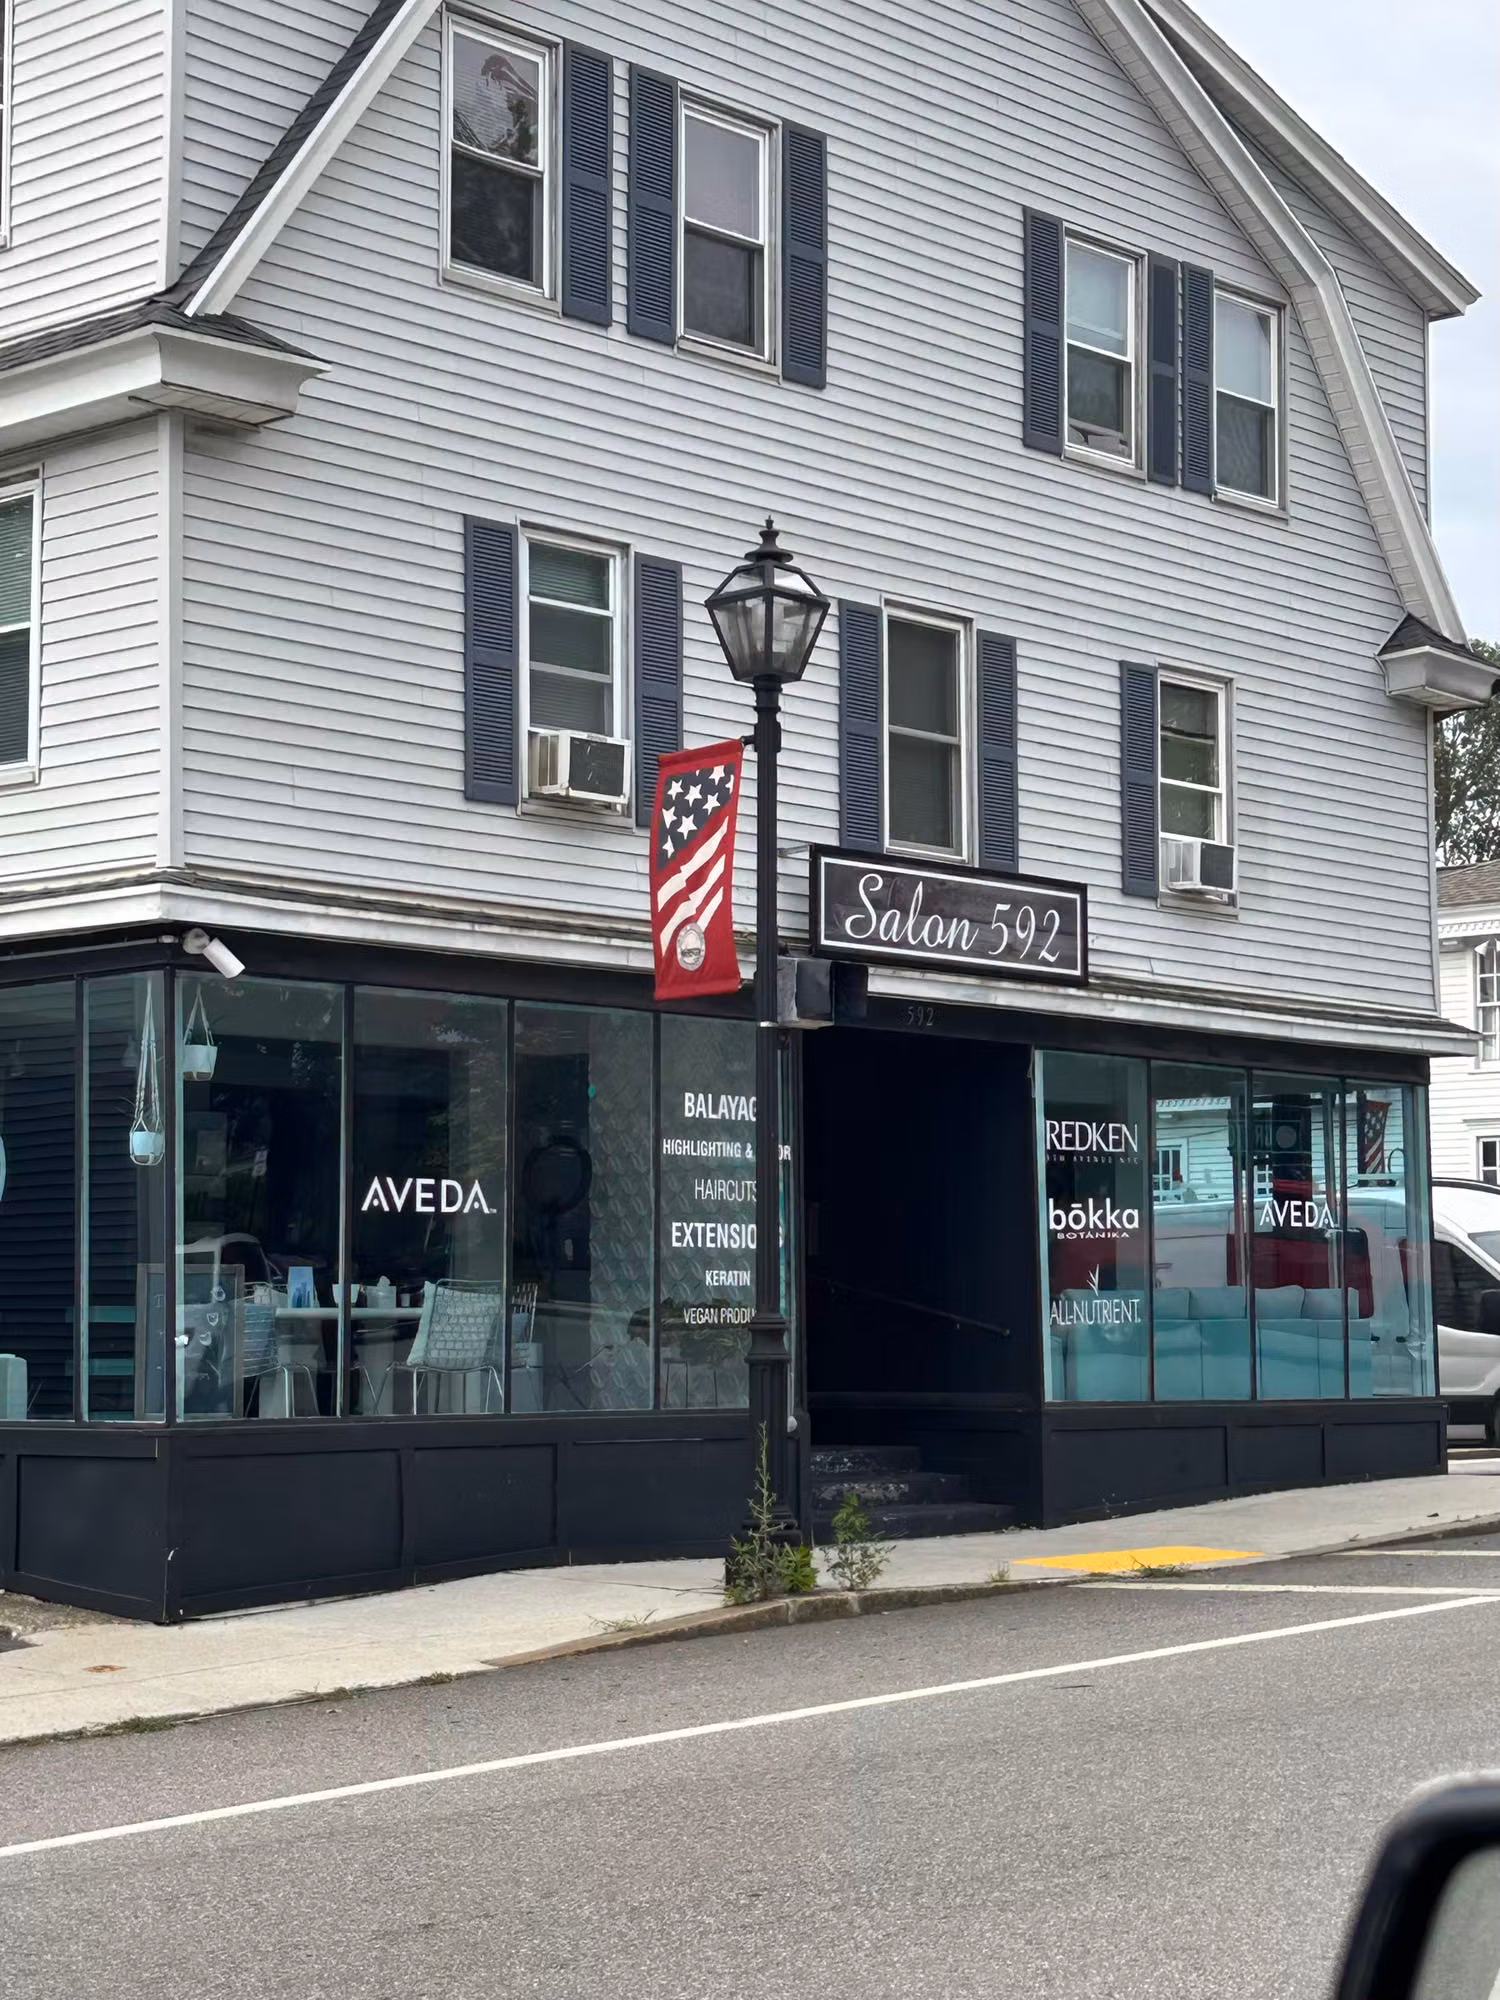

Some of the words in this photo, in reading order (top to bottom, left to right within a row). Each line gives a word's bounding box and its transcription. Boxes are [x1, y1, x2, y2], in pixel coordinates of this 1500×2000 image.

[844, 873, 979, 951] Salon
[988, 903, 1061, 963] 592
[907, 1006, 935, 1027] 592
[684, 1092, 757, 1122] BALAYAG
[663, 1138, 742, 1159] HIGHLIGHTING
[745, 1143, 753, 1159] &
[1045, 1120, 1138, 1152] REDKEN
[361, 1176, 490, 1214] AVEDA
[1049, 1198, 1139, 1230] bōkka
[1259, 1200, 1334, 1228] AVEDA
[671, 1221, 784, 1250] EXTENSIO
[705, 1269, 751, 1287] KERATIN
[683, 1307, 718, 1324] VEGAN
[720, 1307, 756, 1324] PRODU
